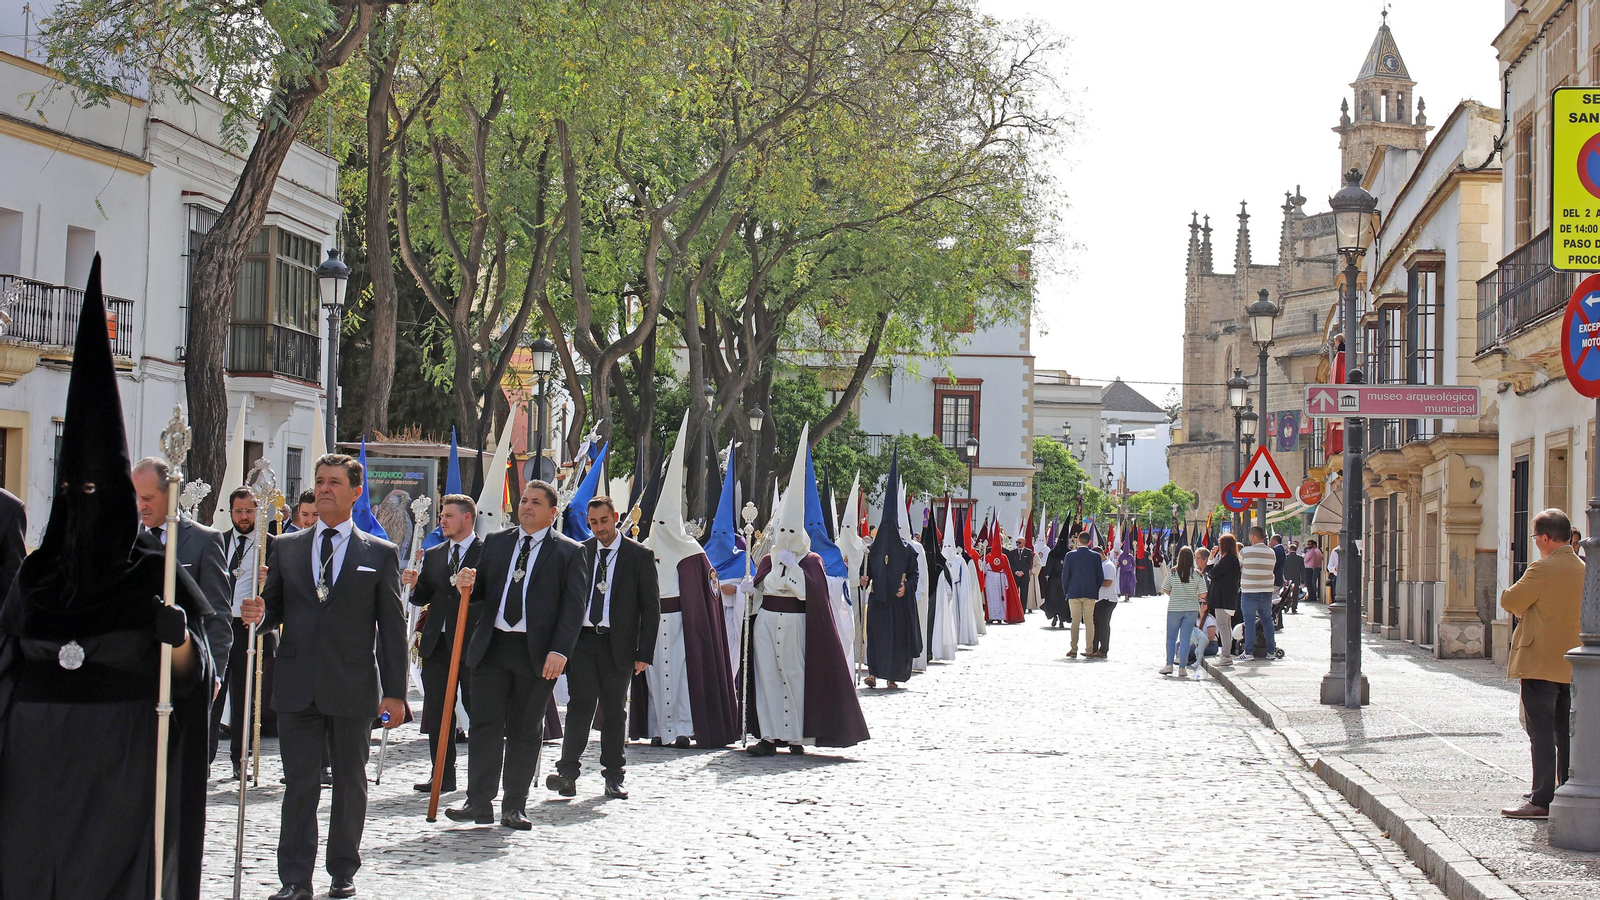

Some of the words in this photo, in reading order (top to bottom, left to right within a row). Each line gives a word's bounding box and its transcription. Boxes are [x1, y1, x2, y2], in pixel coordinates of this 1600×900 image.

[1582, 94, 1600, 104] SE
[1568, 112, 1599, 123] SAN
[1563, 209, 1580, 218] DEL
[1585, 209, 1591, 218] 2
[1560, 224, 1572, 233] DE
[1574, 224, 1598, 233] 14:00
[1563, 239, 1592, 248] PASO
[1579, 321, 1600, 333] EXCEP
[1581, 337, 1600, 348] MOTO
[1406, 392, 1475, 403] arqueológico
[1424, 404, 1475, 414] municipal
